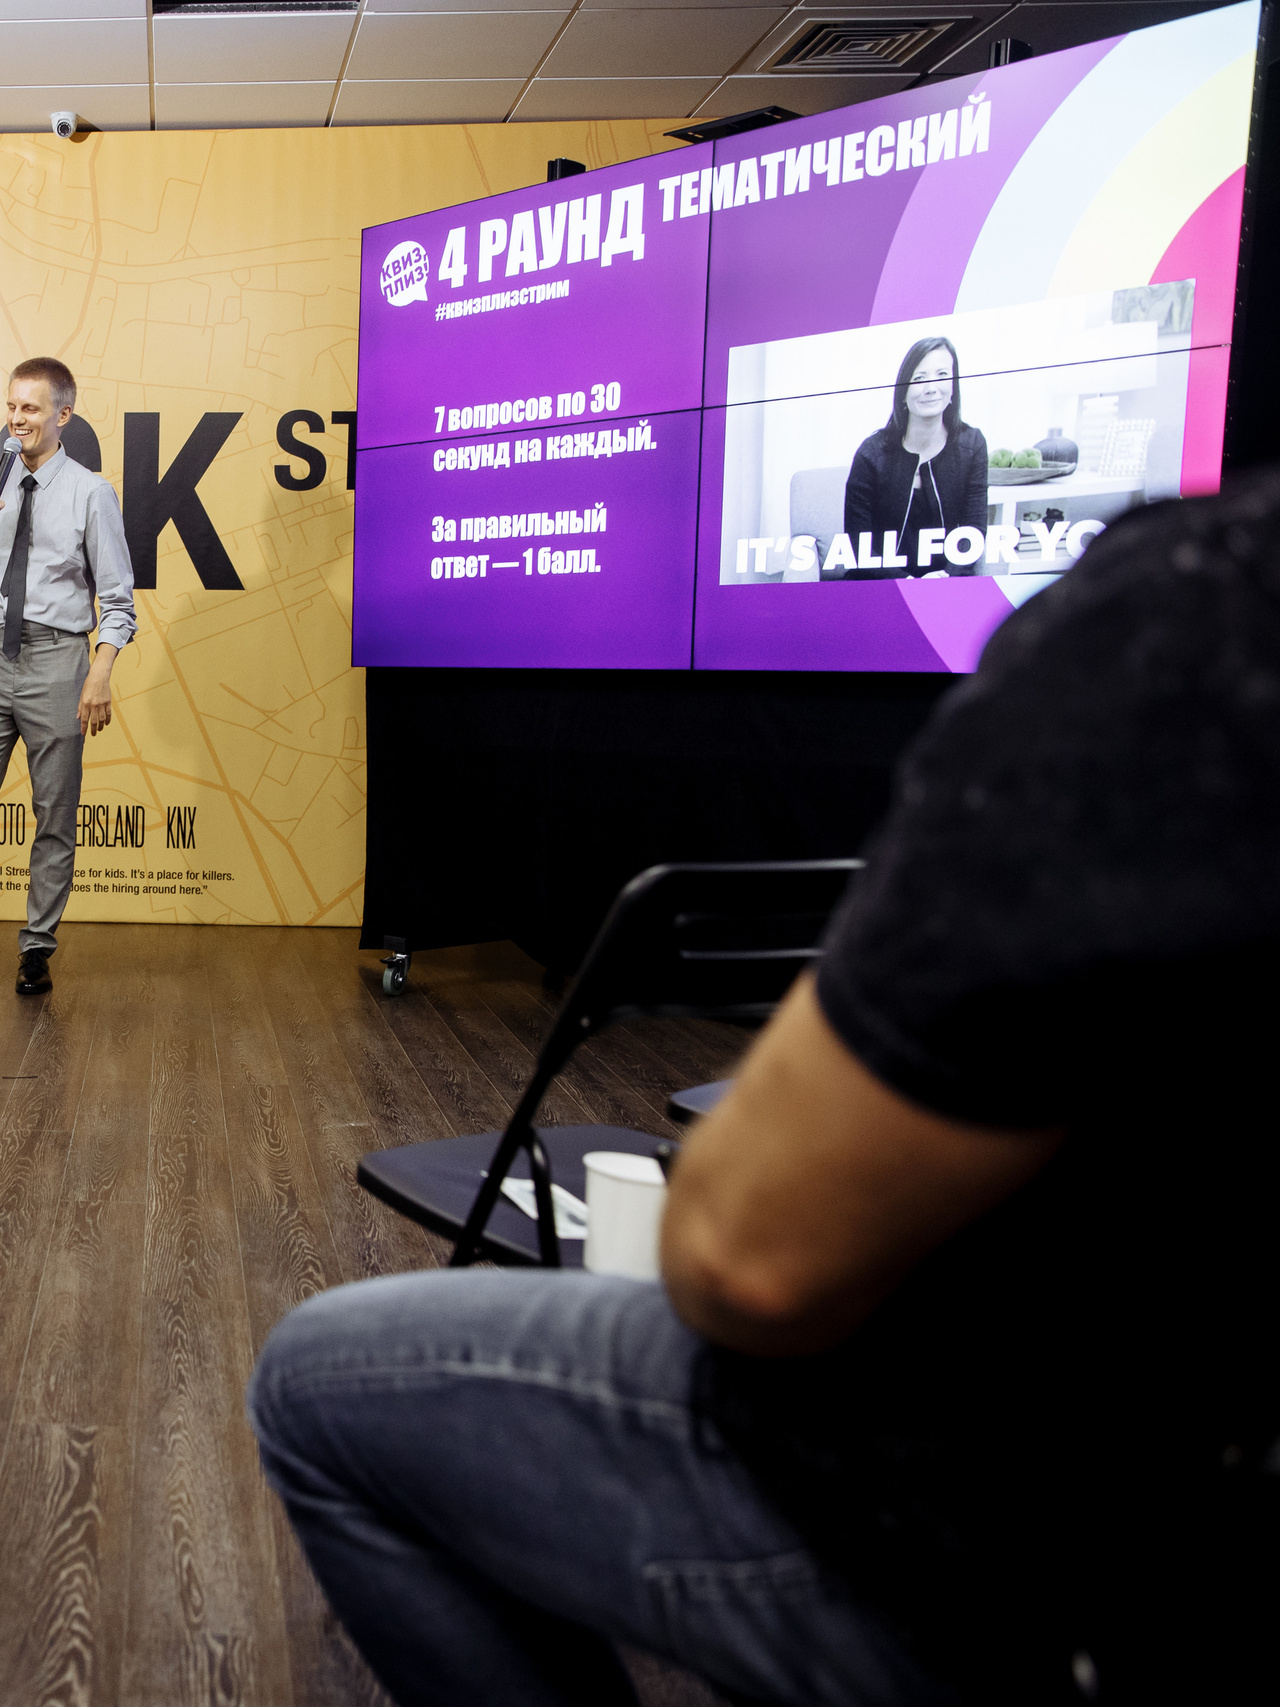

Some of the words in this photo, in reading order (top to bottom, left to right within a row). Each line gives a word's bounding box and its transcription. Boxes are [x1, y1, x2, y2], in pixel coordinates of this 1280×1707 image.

[438, 226, 468, 289] 4
[478, 182, 645, 283] РАУНД
[658, 91, 992, 223] ТЕМАТИЧЕСКИЙ
[434, 406, 445, 434] 7
[448, 395, 552, 431] вопросов
[556, 390, 586, 418] по
[590, 381, 622, 413] 30
[433, 441, 511, 472] секунд
[514, 438, 542, 464] на
[546, 418, 658, 460] каждый.
[431, 515, 457, 543] За
[460, 501, 608, 543] правильный
[430, 554, 490, 580] ответ
[523, 547, 534, 576] 1
[537, 546, 602, 576] балл.
[736, 533, 819, 574] IT'S
[822, 530, 908, 570] ALL
[917, 525, 1020, 567] FOR
[1030, 518, 1107, 562] YO
[75, 804, 146, 848] ERISLAND
[166, 805, 197, 850] KNX
[5, 865, 31, 877] Stree
[88, 868, 103, 879] for
[104, 868, 129, 879] kids.
[130, 869, 146, 879] It's
[147, 870, 154, 880] a
[156, 869, 183, 882] place
[186, 869, 200, 881] for
[202, 870, 236, 881] killers.
[6, 881, 22, 891] the
[93, 883, 110, 893] the
[111, 883, 140, 896] hiring
[142, 884, 177, 895] around
